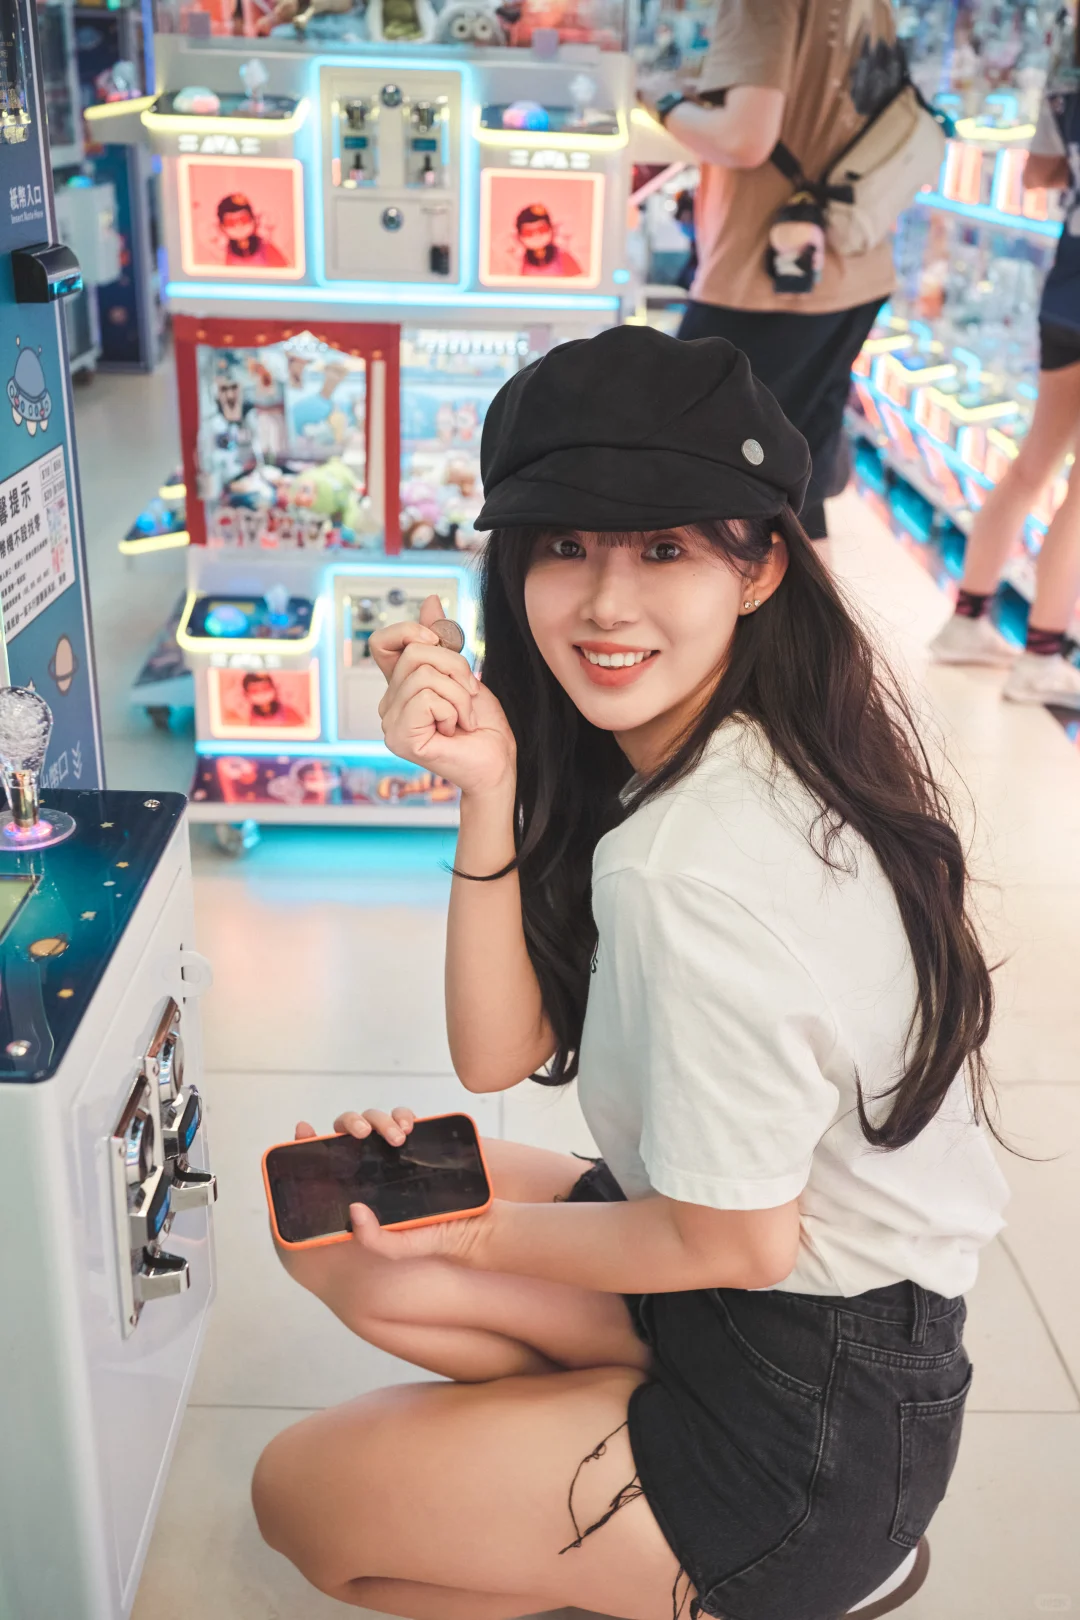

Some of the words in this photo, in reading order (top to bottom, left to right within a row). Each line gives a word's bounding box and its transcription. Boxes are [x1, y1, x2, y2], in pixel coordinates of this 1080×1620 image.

[9, 184, 41, 210] 紙幣入口
[11, 213, 24, 224] Insert
[24, 210, 34, 221] Note
[34, 209, 43, 219] Here
